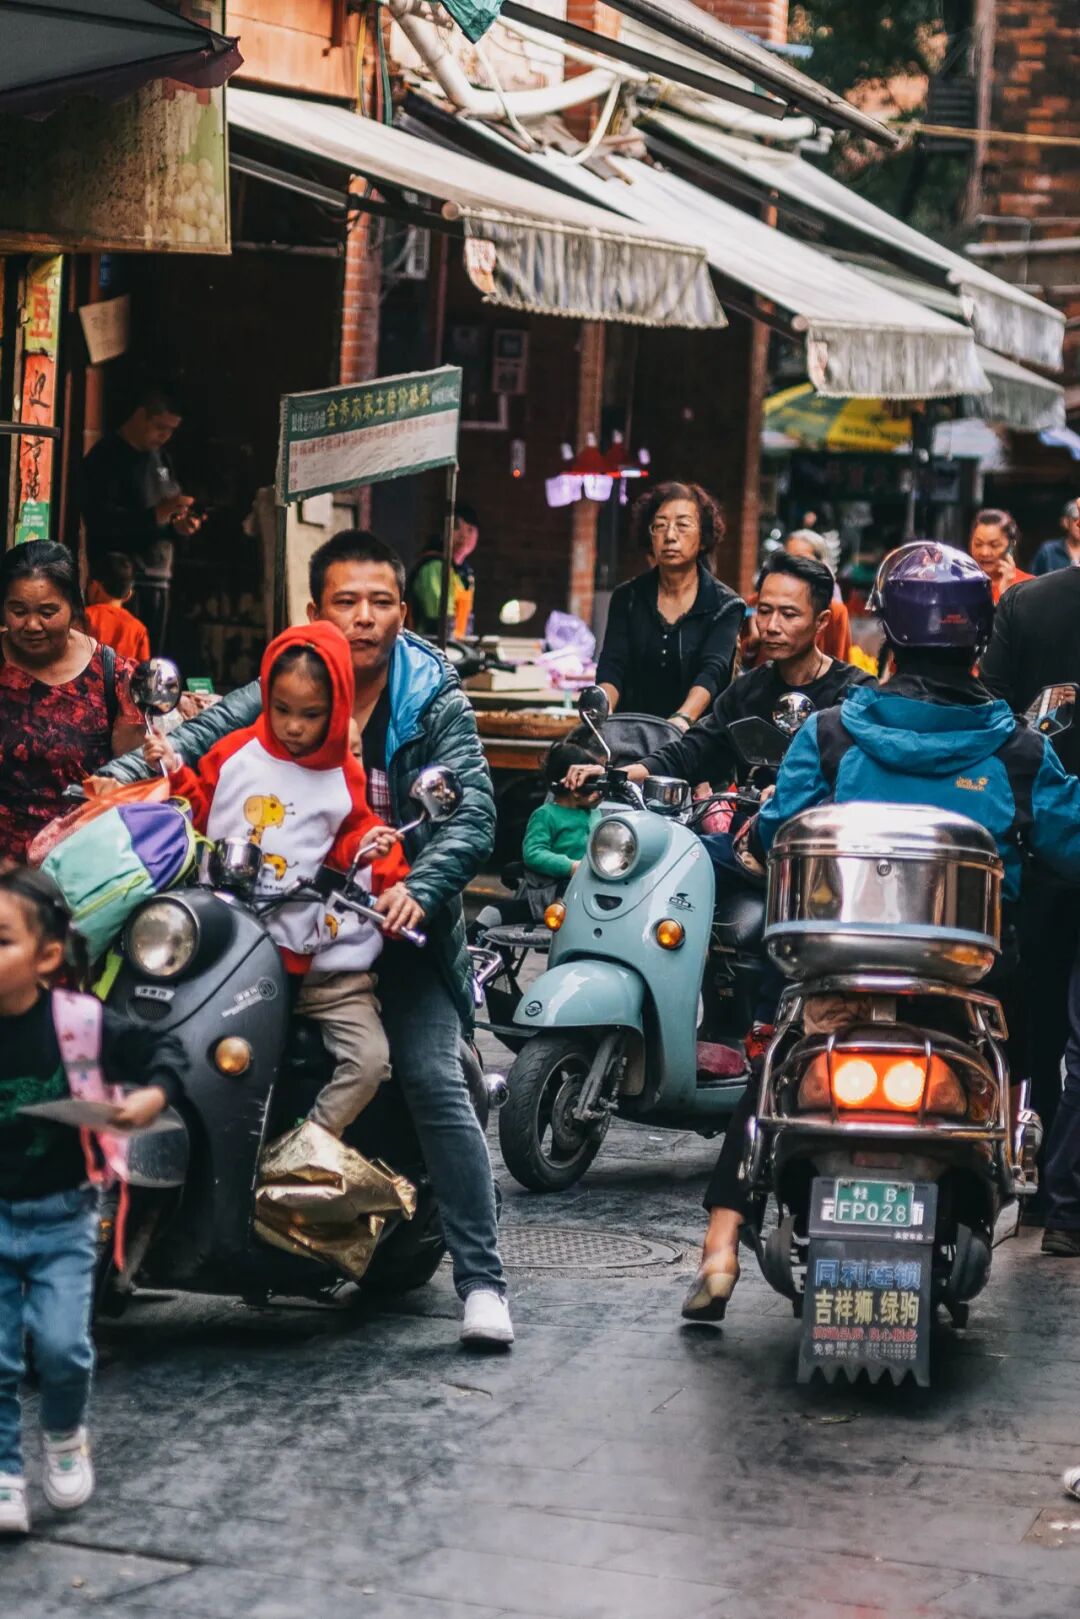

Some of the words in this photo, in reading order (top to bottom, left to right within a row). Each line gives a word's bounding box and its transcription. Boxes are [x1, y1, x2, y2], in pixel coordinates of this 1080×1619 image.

[886, 1188, 897, 1202] B
[838, 1202, 906, 1223] FP028
[815, 1259, 922, 1290] 同利连锁
[815, 1288, 920, 1327] 吉祥狮、绿驹
